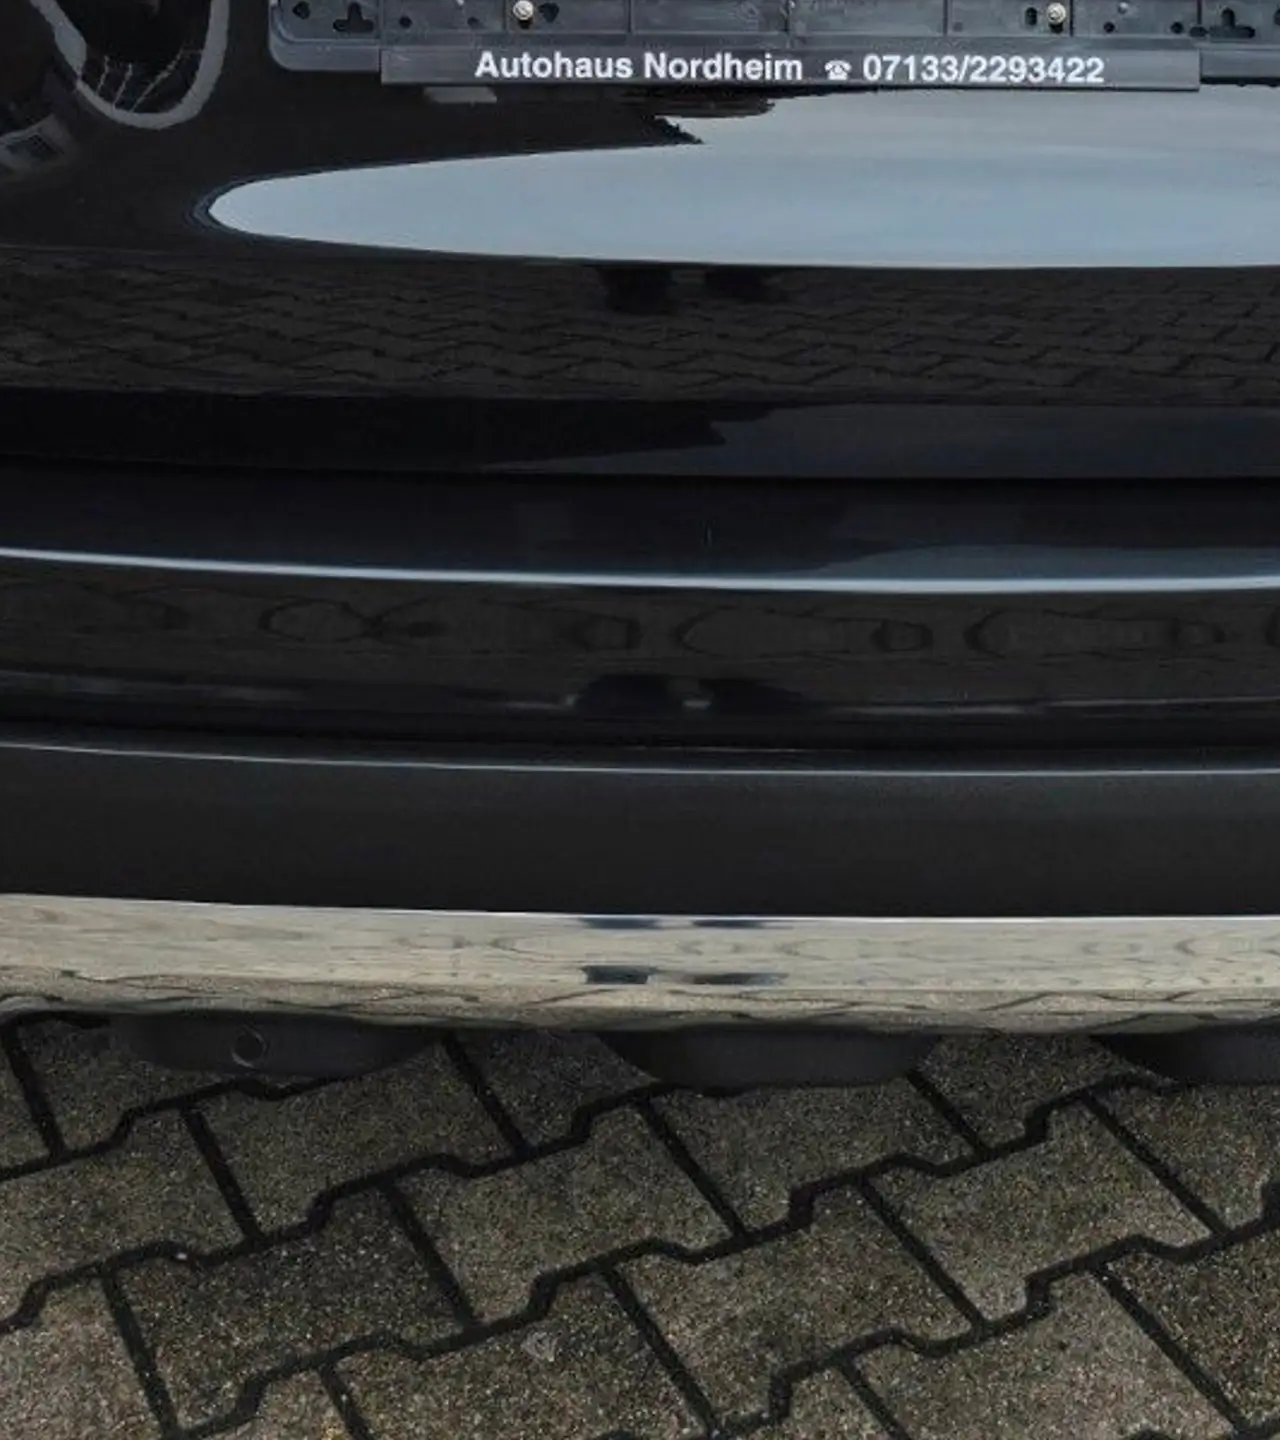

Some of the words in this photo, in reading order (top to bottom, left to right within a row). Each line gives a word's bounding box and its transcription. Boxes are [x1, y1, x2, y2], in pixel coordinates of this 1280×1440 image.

[474, 51, 633, 79] Autohaus
[643, 52, 803, 81] Nordheim
[862, 53, 1106, 84] 07133/2293422
